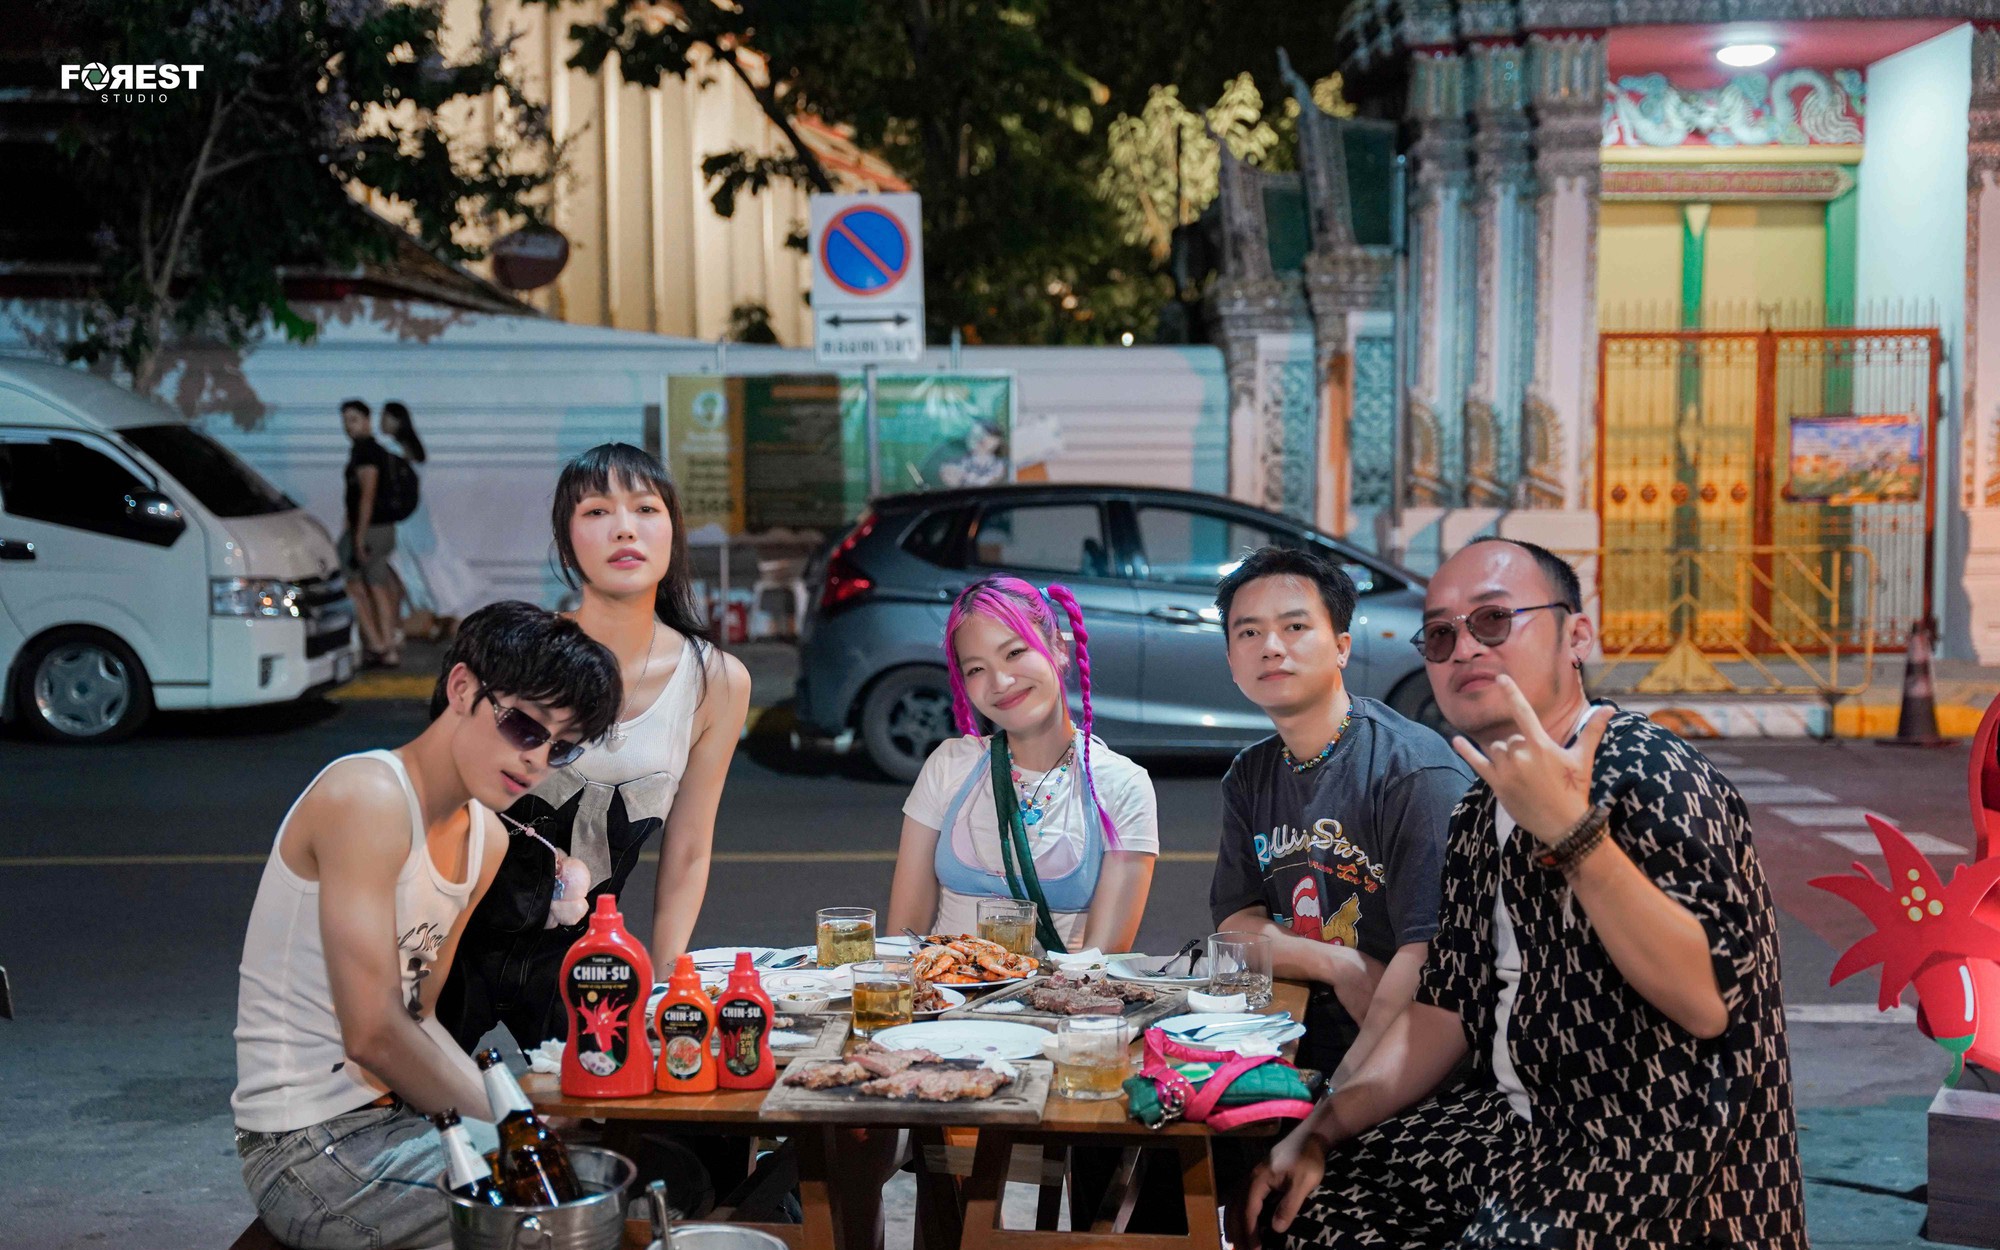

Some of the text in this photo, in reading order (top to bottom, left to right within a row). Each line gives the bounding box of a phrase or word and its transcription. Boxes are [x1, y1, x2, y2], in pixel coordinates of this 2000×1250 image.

[573, 965, 630, 981] CHIN-SU
[664, 1011, 702, 1022] CHIN-SU
[722, 1006, 761, 1018] CHIN-SU
